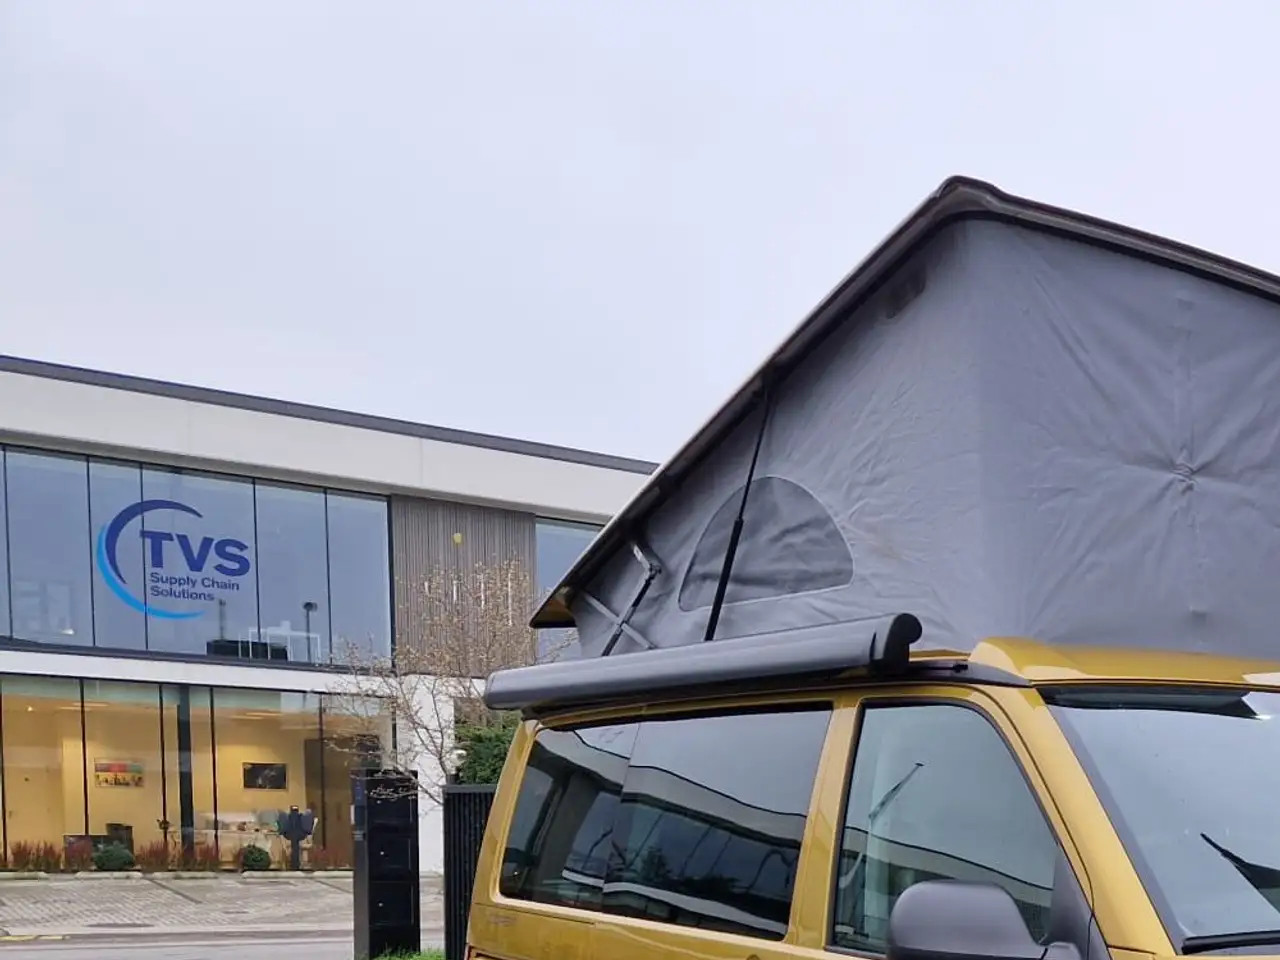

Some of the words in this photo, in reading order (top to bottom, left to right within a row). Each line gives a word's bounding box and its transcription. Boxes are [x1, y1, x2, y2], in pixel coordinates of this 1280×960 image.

[140, 529, 250, 577] TVS
[150, 571, 197, 587] Supply
[201, 577, 240, 591] Chain
[150, 585, 214, 601] Solutions
